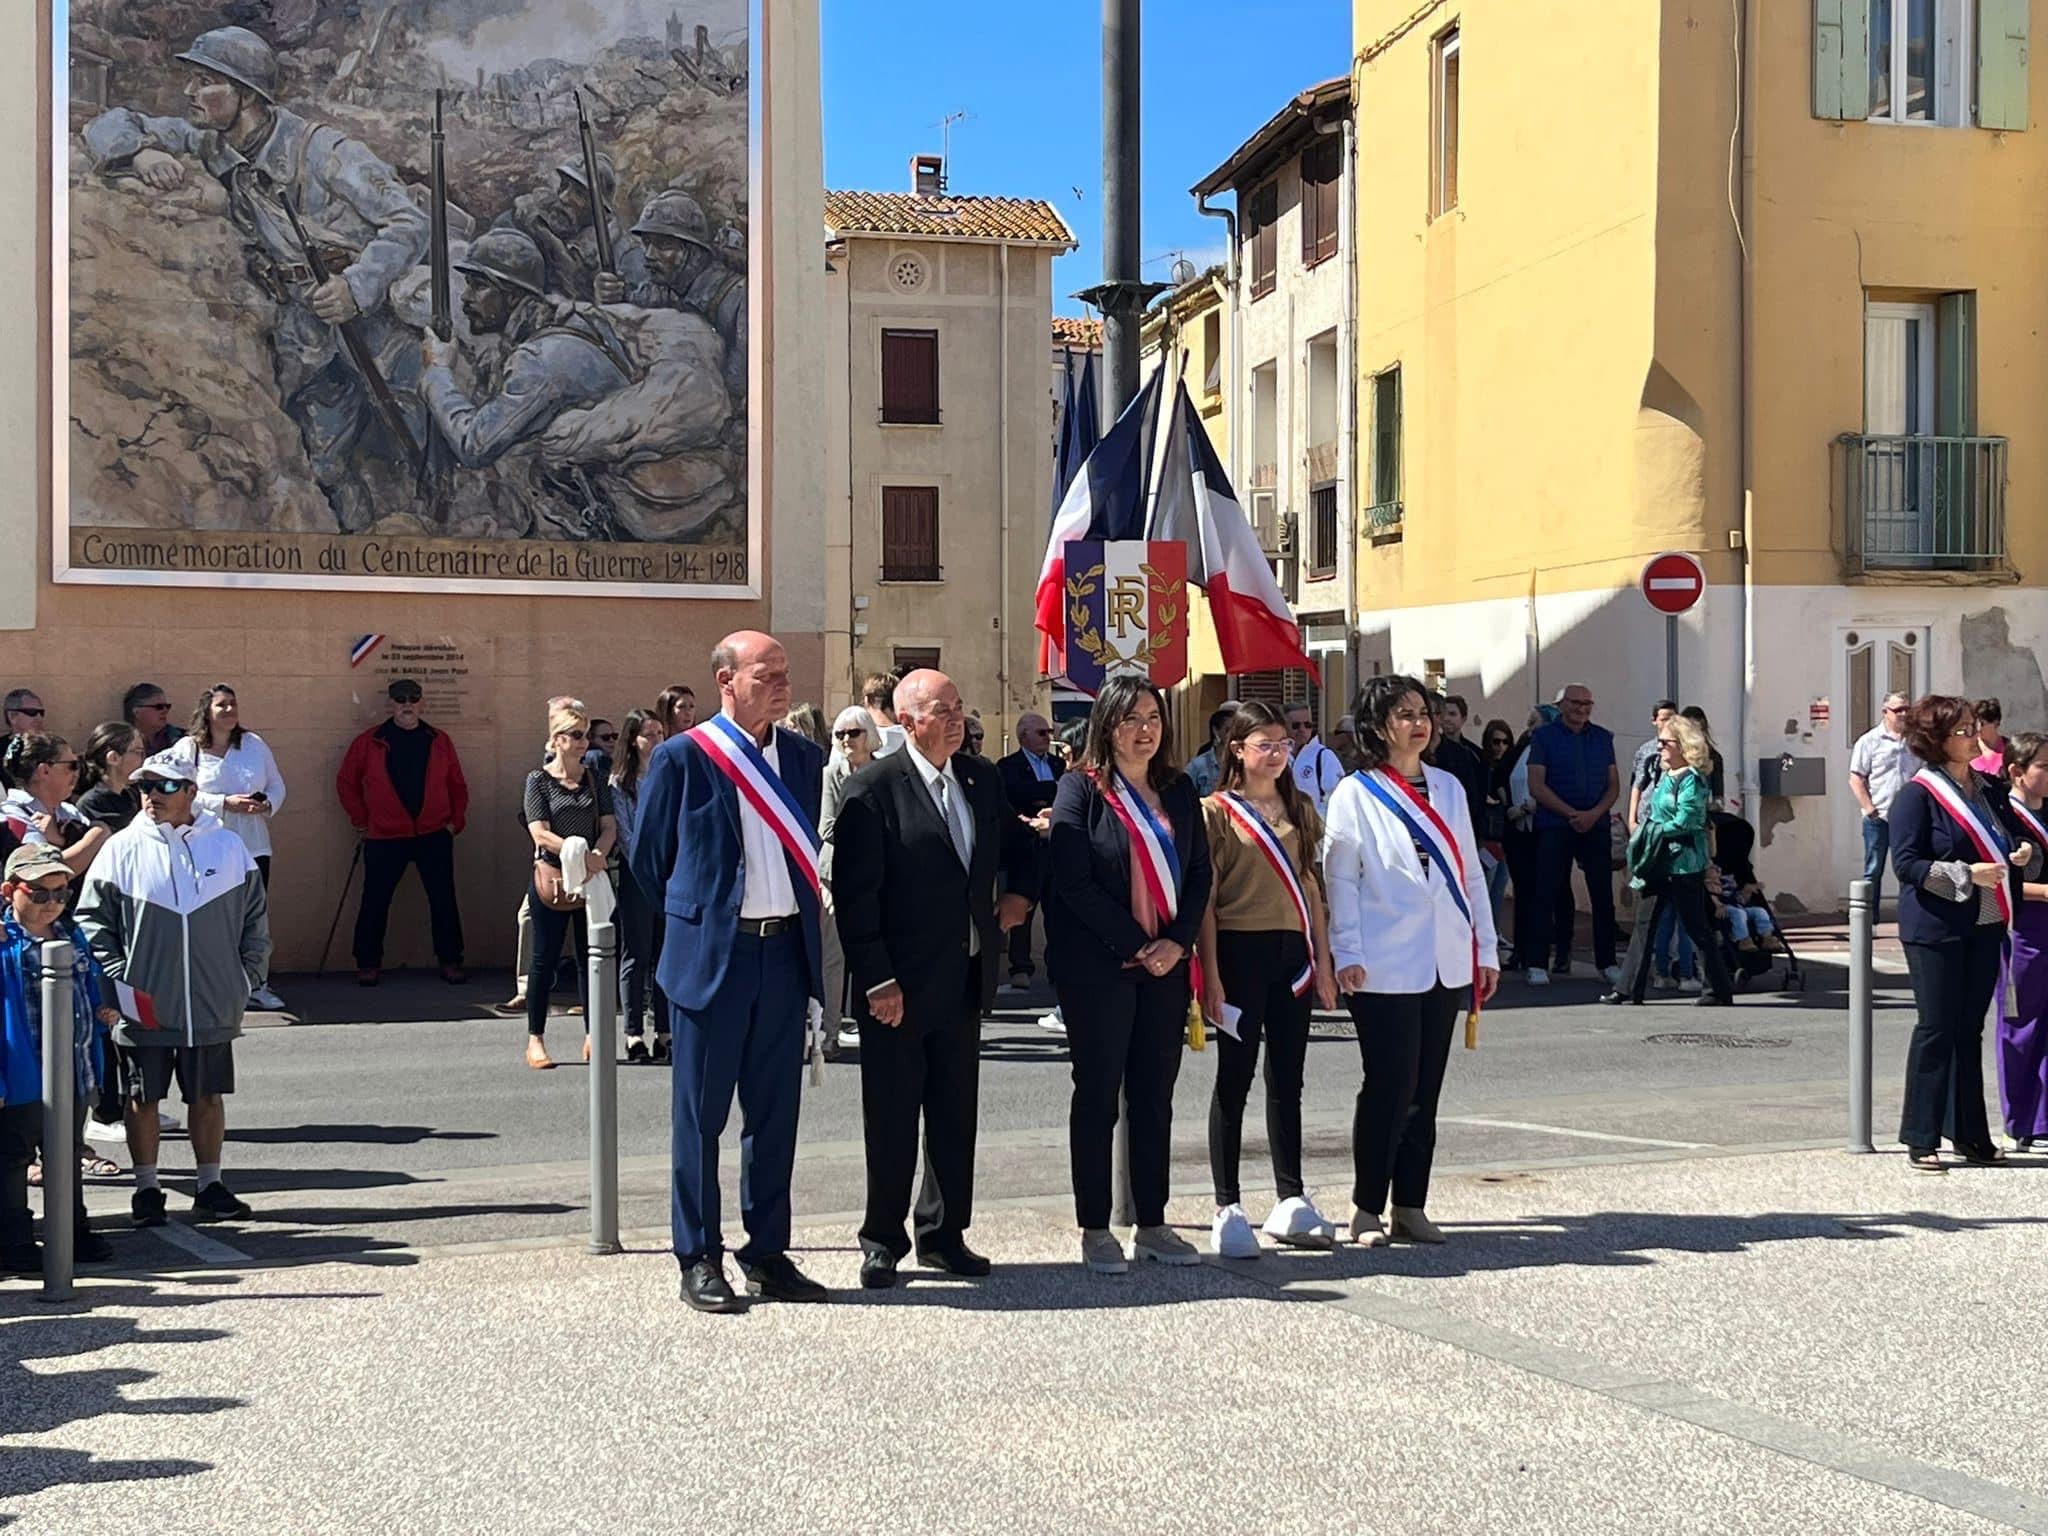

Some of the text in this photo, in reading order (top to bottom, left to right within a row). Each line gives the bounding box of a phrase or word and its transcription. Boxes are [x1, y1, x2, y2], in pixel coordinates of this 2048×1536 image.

[318, 541, 346, 571] du
[362, 542, 509, 576] Centenaire
[516, 547, 541, 576] de
[550, 548, 568, 577] la
[575, 549, 652, 581] Guerre
